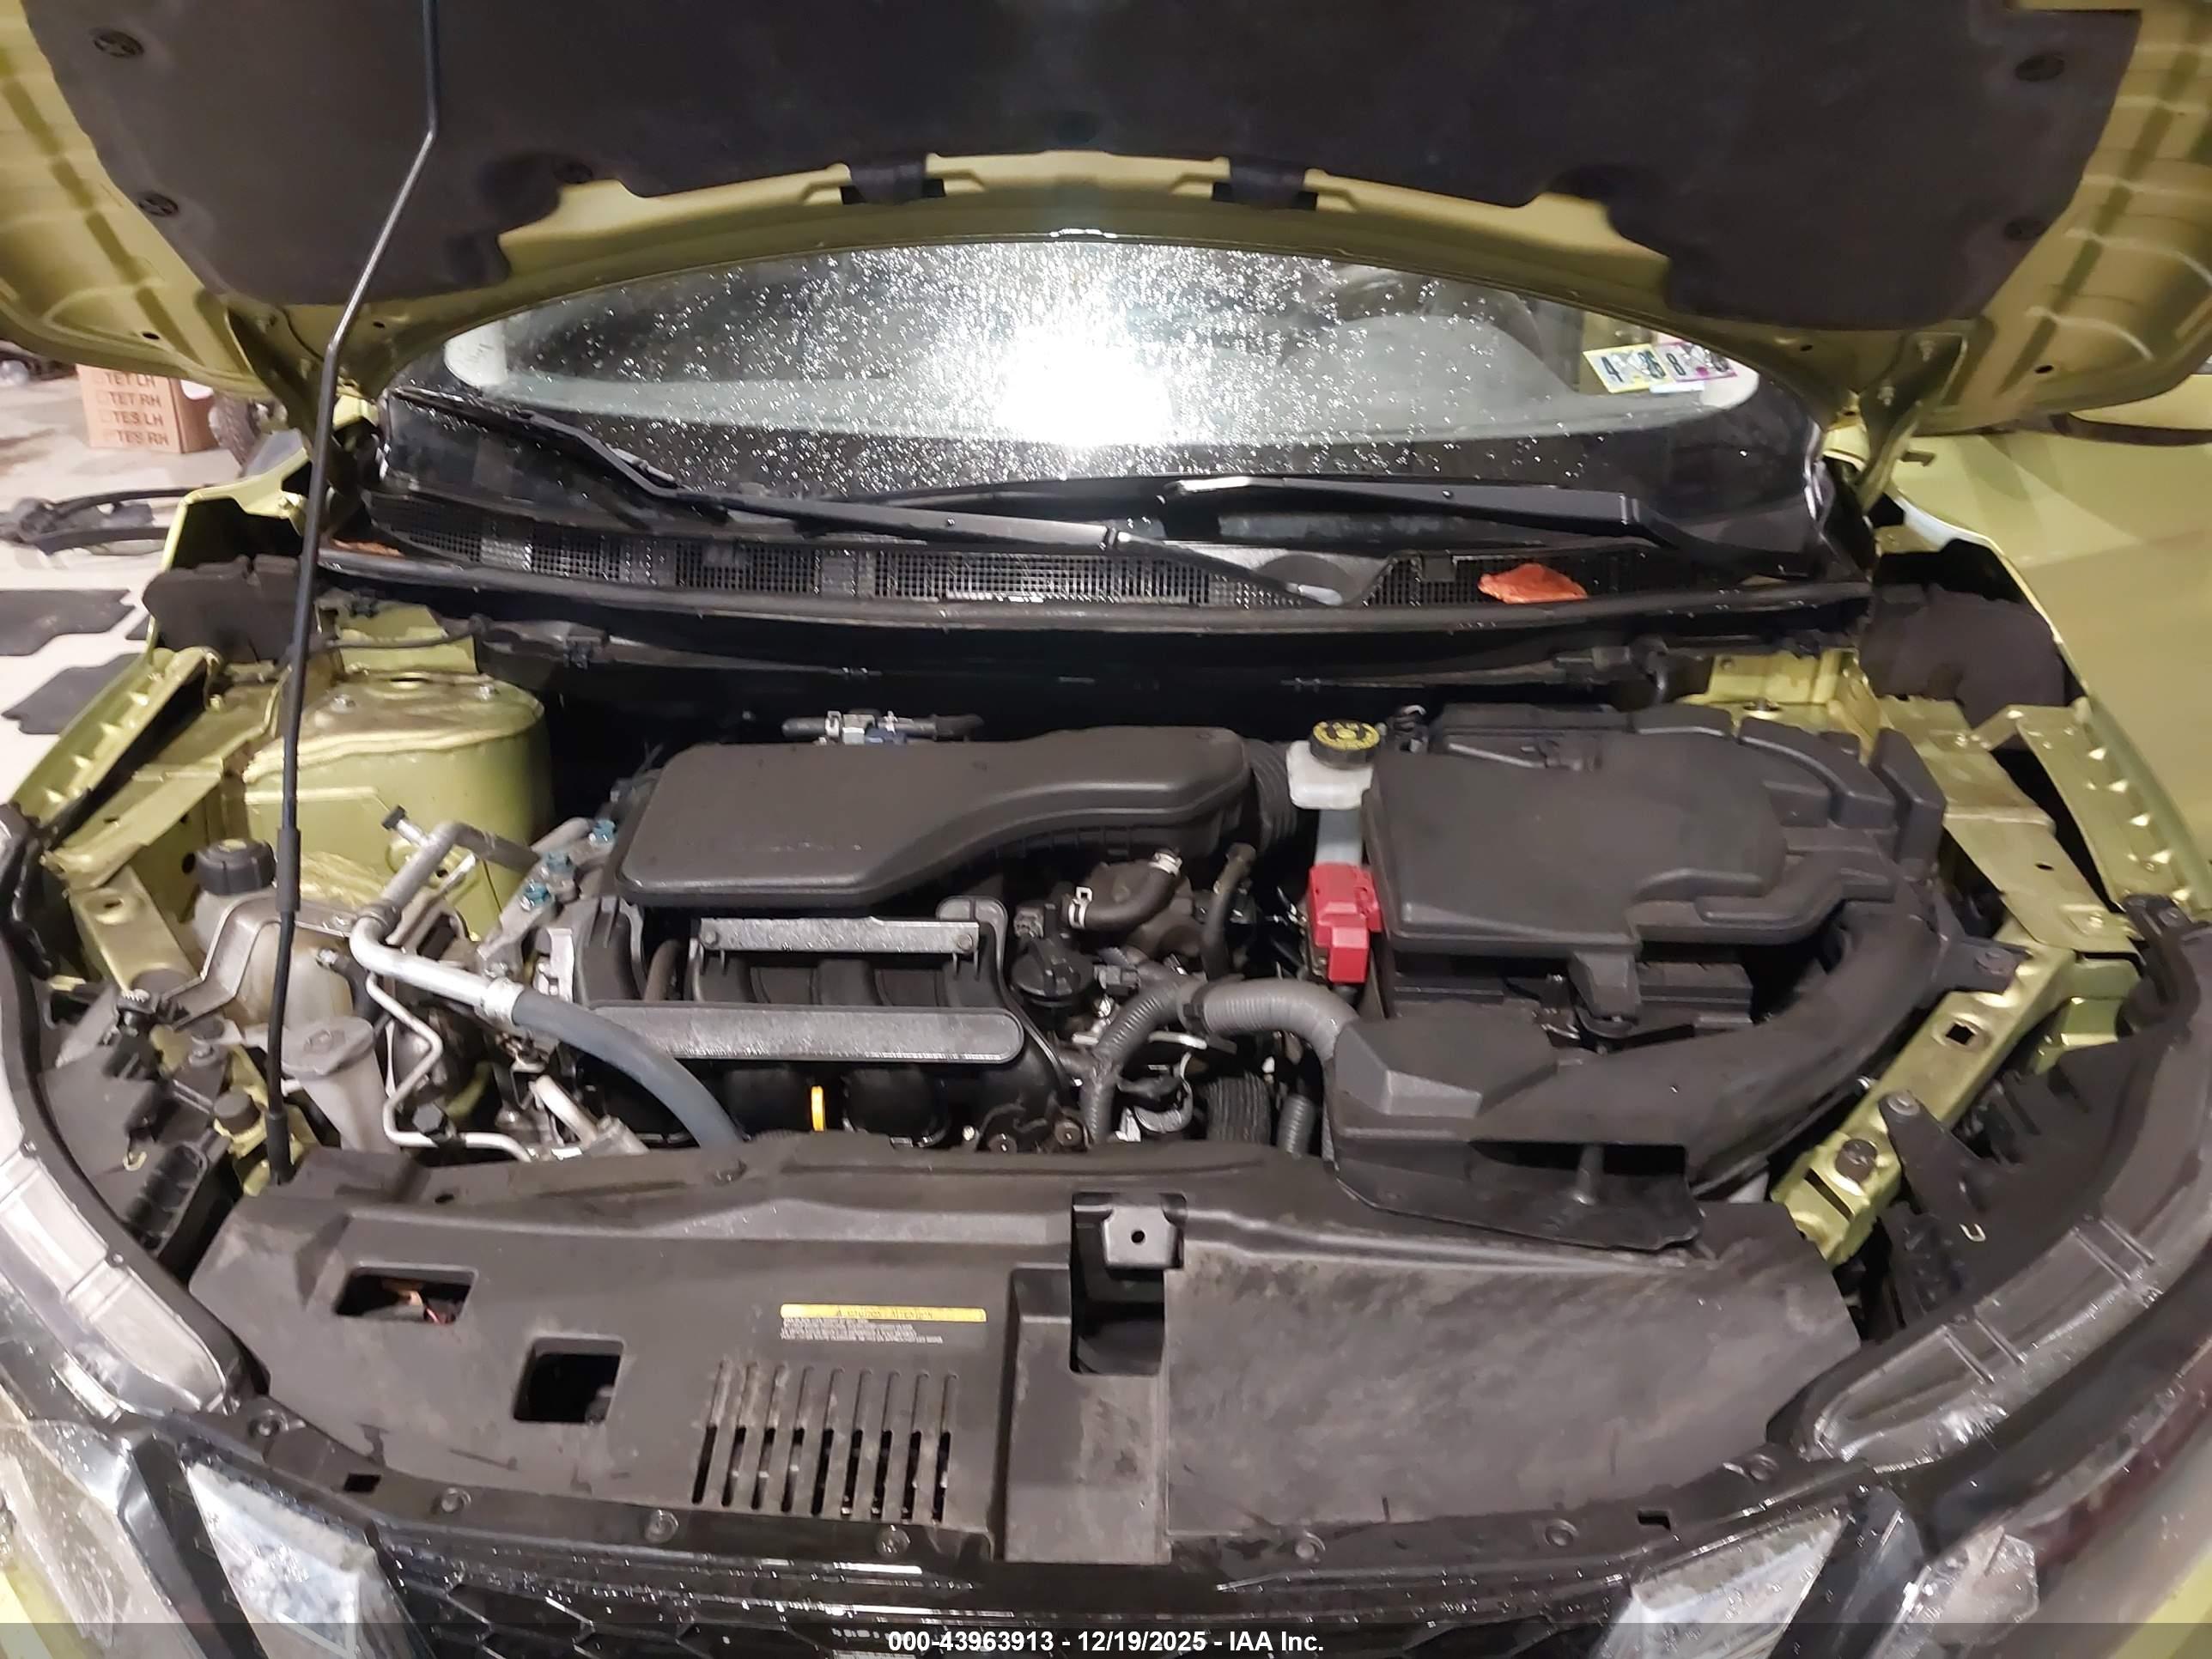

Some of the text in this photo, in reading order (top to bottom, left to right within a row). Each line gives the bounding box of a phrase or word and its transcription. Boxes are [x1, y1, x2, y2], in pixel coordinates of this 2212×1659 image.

[1601, 356, 1623, 383] 4
[1667, 353, 1686, 376] 8
[139, 392, 161, 408] RH
[112, 410, 165, 427] TES LH
[147, 431, 170, 446] RH
